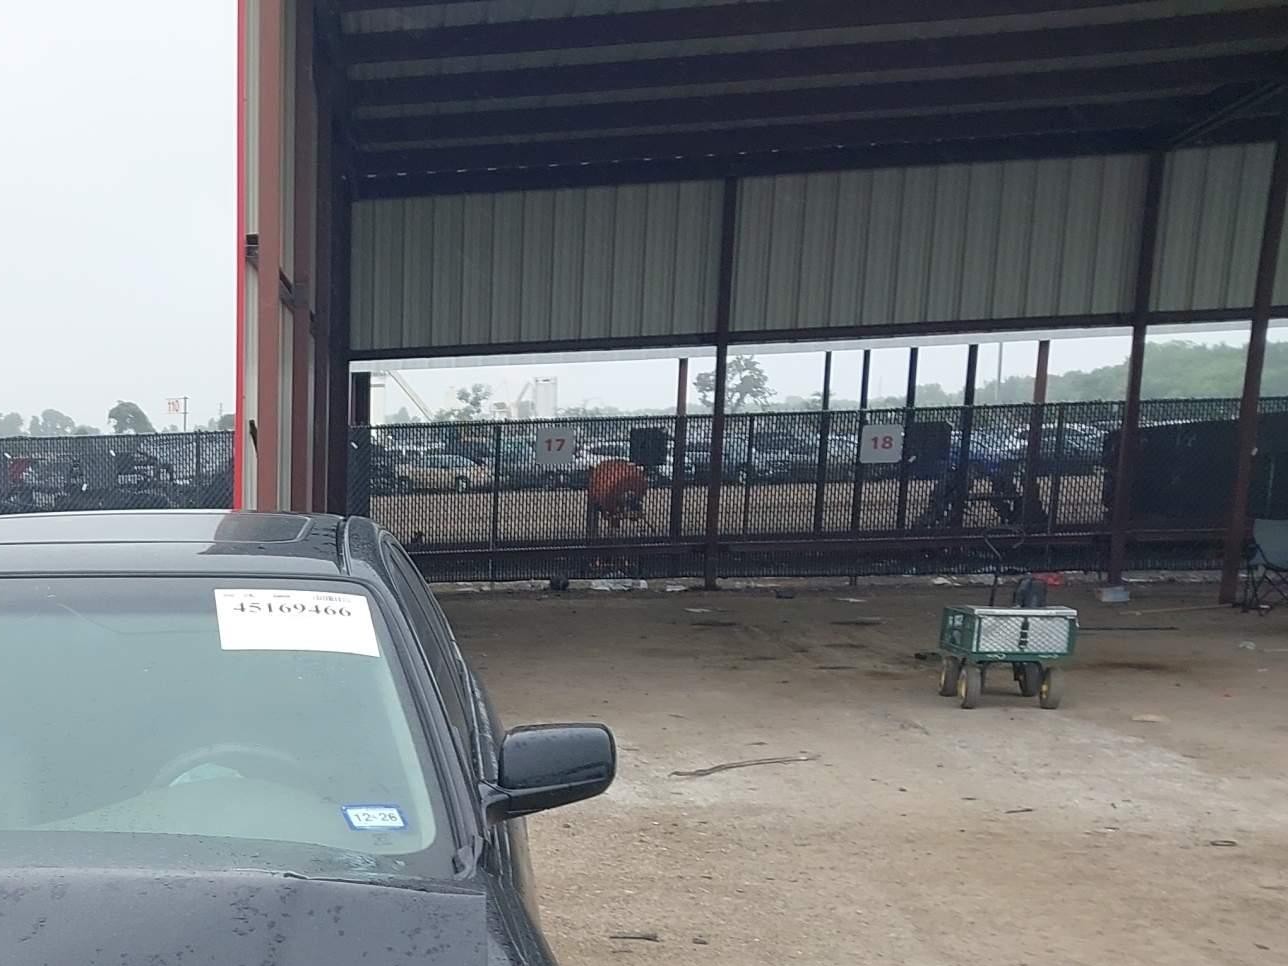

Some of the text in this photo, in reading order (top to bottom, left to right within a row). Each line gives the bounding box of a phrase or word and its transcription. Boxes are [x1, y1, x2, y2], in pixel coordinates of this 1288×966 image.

[544, 438, 566, 452] 17
[872, 435, 893, 450] 18
[233, 601, 352, 617] 45169466
